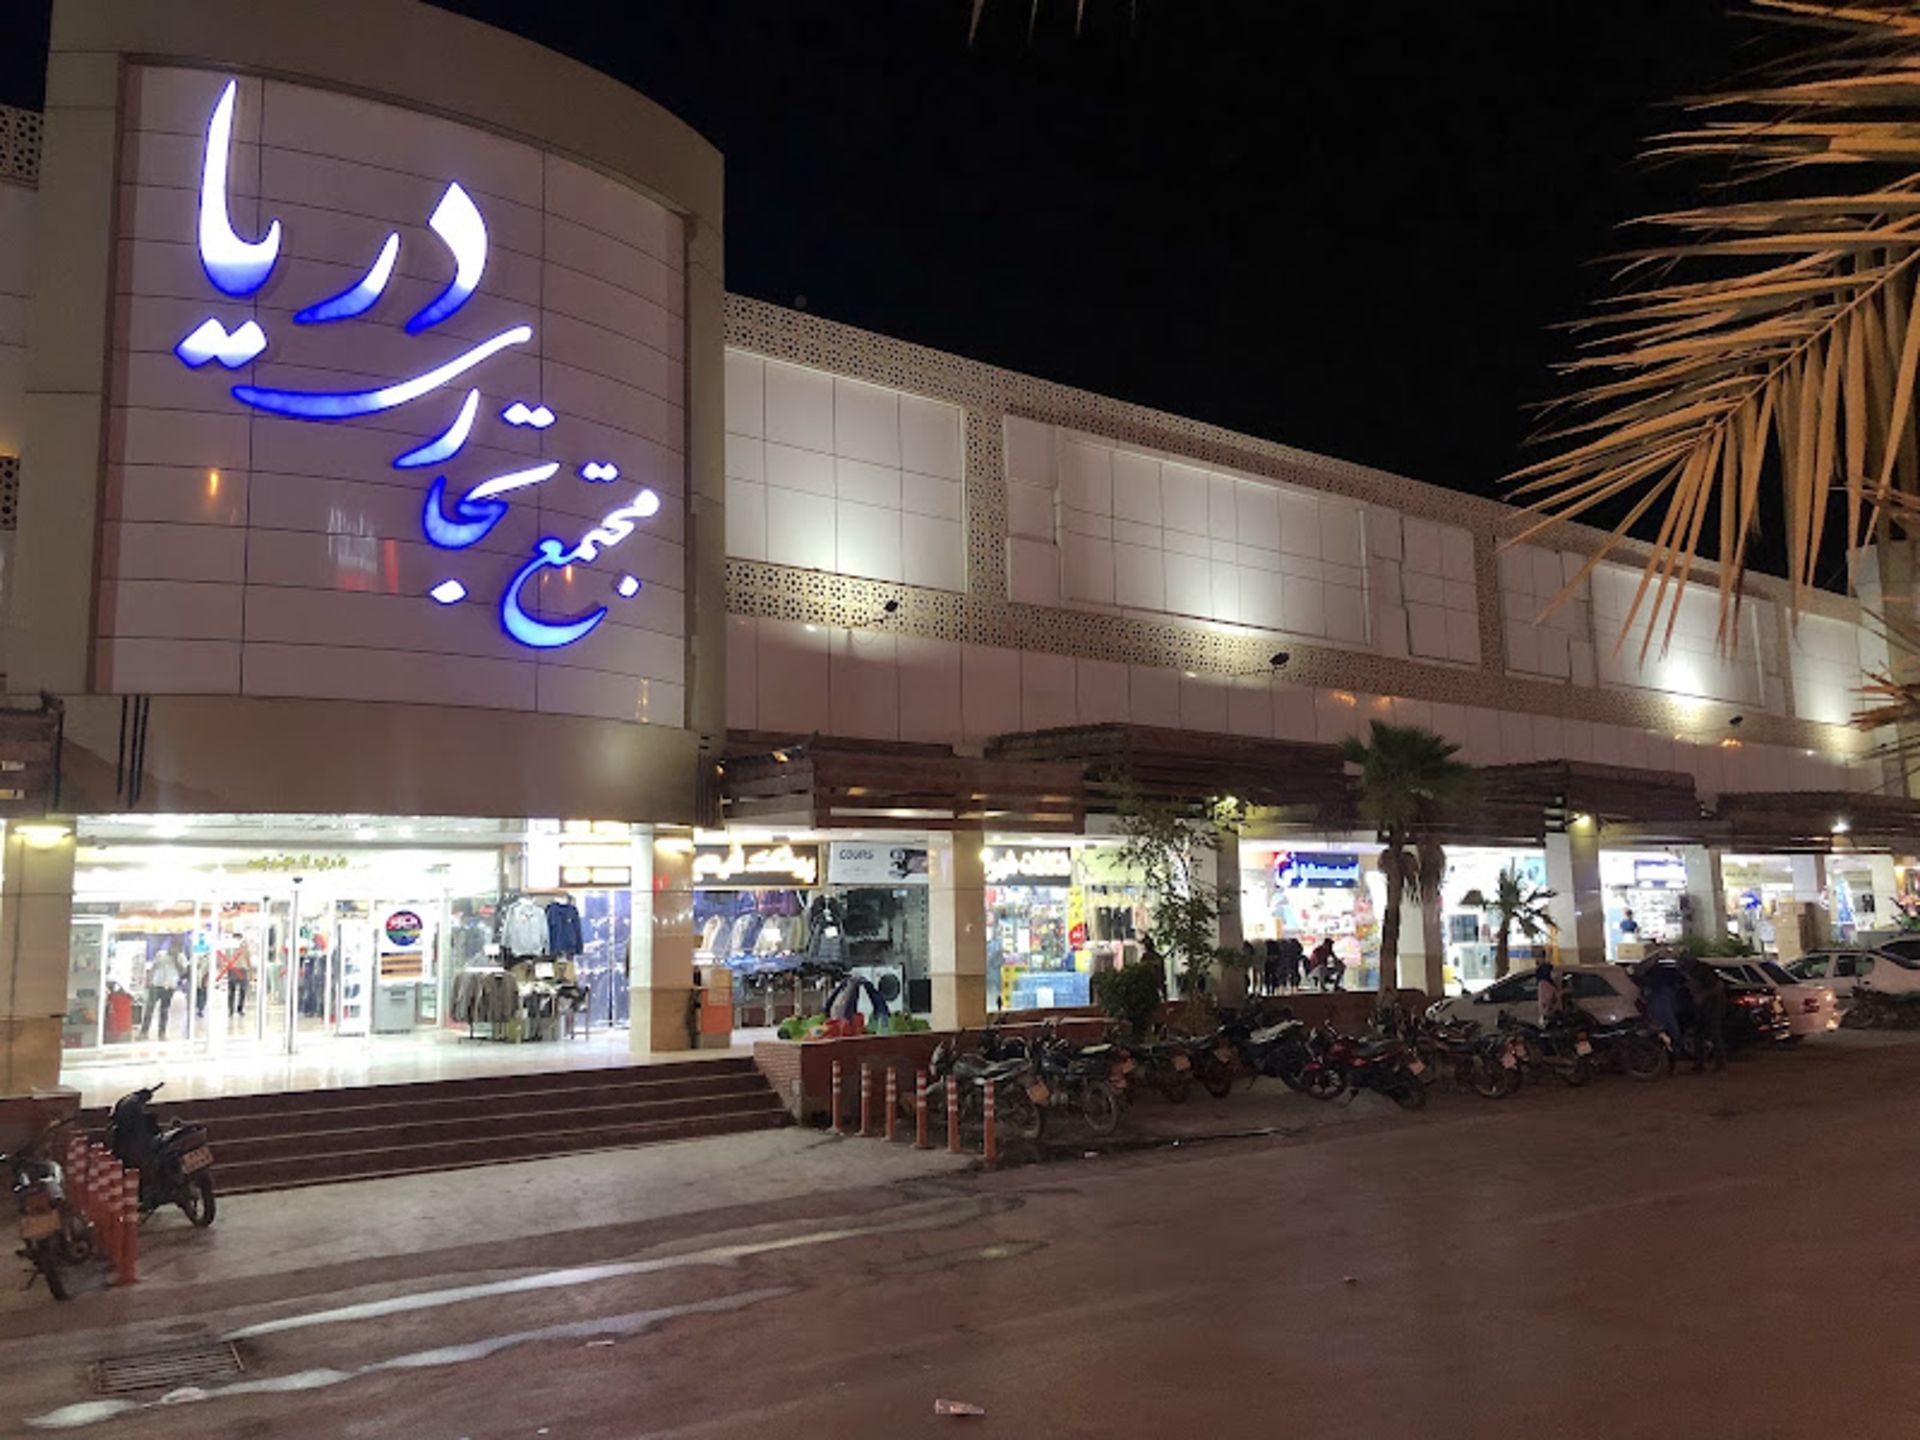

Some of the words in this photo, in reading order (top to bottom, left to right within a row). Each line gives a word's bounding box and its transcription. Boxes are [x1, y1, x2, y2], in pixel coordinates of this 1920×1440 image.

[173, 78, 489, 369] دریا
[231, 324, 561, 605] تجاری
[500, 461, 661, 648] مجتمع
